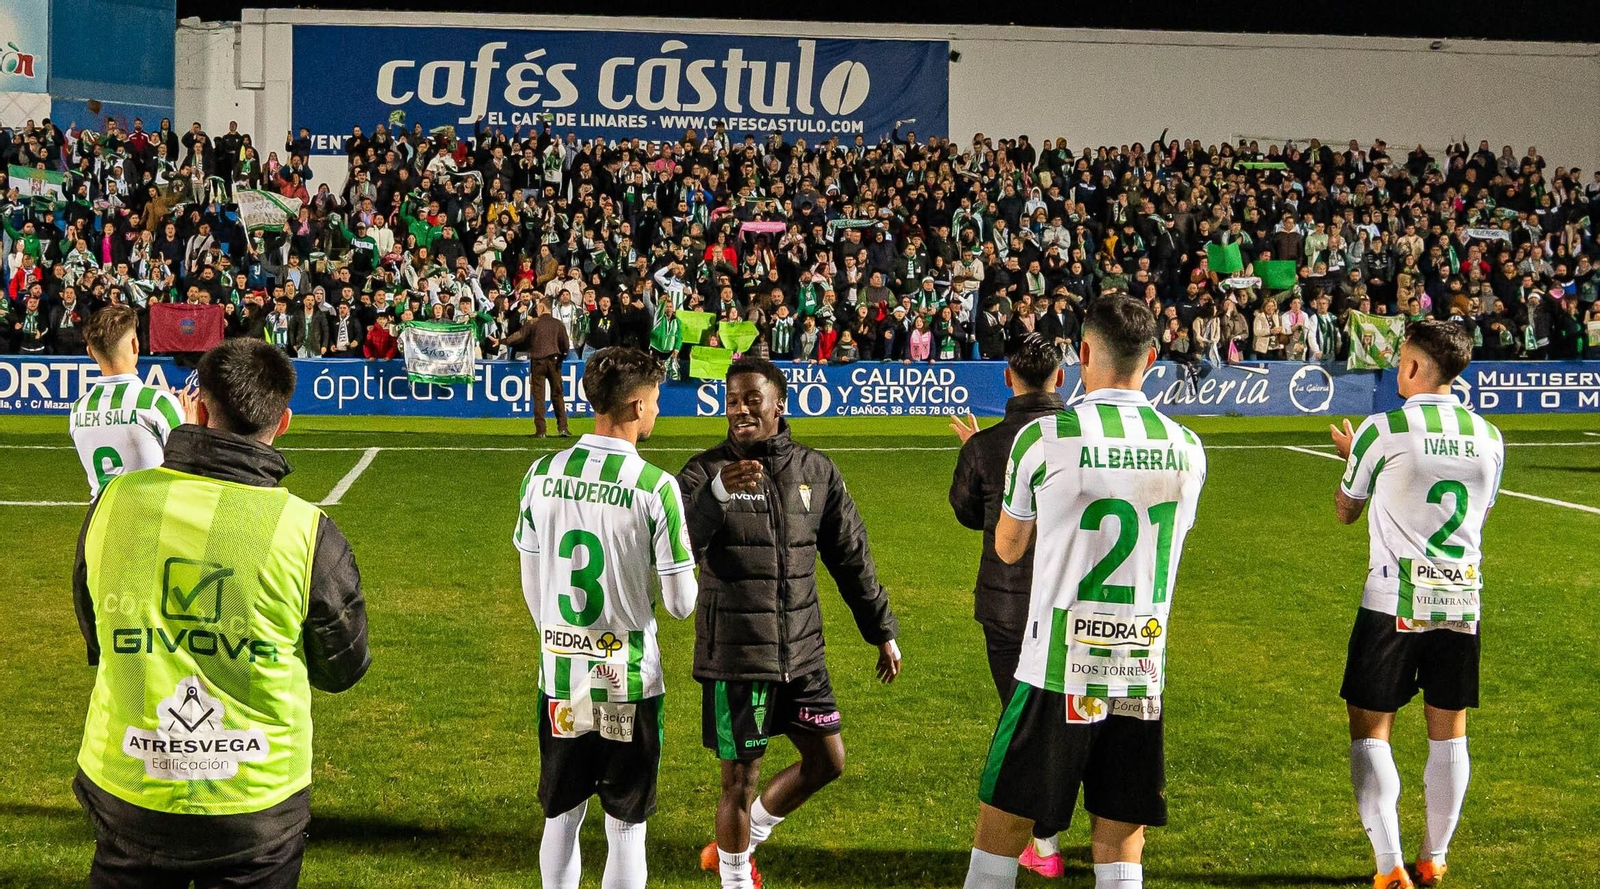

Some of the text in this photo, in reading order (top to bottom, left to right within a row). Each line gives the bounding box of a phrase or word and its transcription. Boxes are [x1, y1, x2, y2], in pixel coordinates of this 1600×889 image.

[376, 39, 870, 125] cafés cástulo
[488, 113, 507, 125] EL
[556, 113, 577, 127] DE
[580, 114, 648, 129] LINARES
[659, 115, 864, 133] WWW.CAFESCASTULO.COM
[851, 368, 956, 386] CALIDAD
[15, 400, 22, 409] 6
[30, 400, 42, 409] C/
[837, 386, 969, 404] Y SERVICIO
[75, 409, 138, 427] ALEX SALA
[836, 405, 970, 416] C/ BAÑOS, 38 653 78 06 04
[1424, 434, 1480, 458] IVÁN R.
[1079, 443, 1190, 471] ALBARRÁN
[542, 477, 635, 509] CALDERÓN
[730, 492, 765, 501] IVOVA
[1425, 479, 1469, 559] 2
[1077, 498, 1179, 605] 21
[558, 529, 605, 627] 3
[112, 627, 279, 663] GIVOVA
[1071, 663, 1148, 677] DOS TORRES
[129, 735, 262, 754] ATRESVEGA
[152, 757, 229, 771] Edificación
